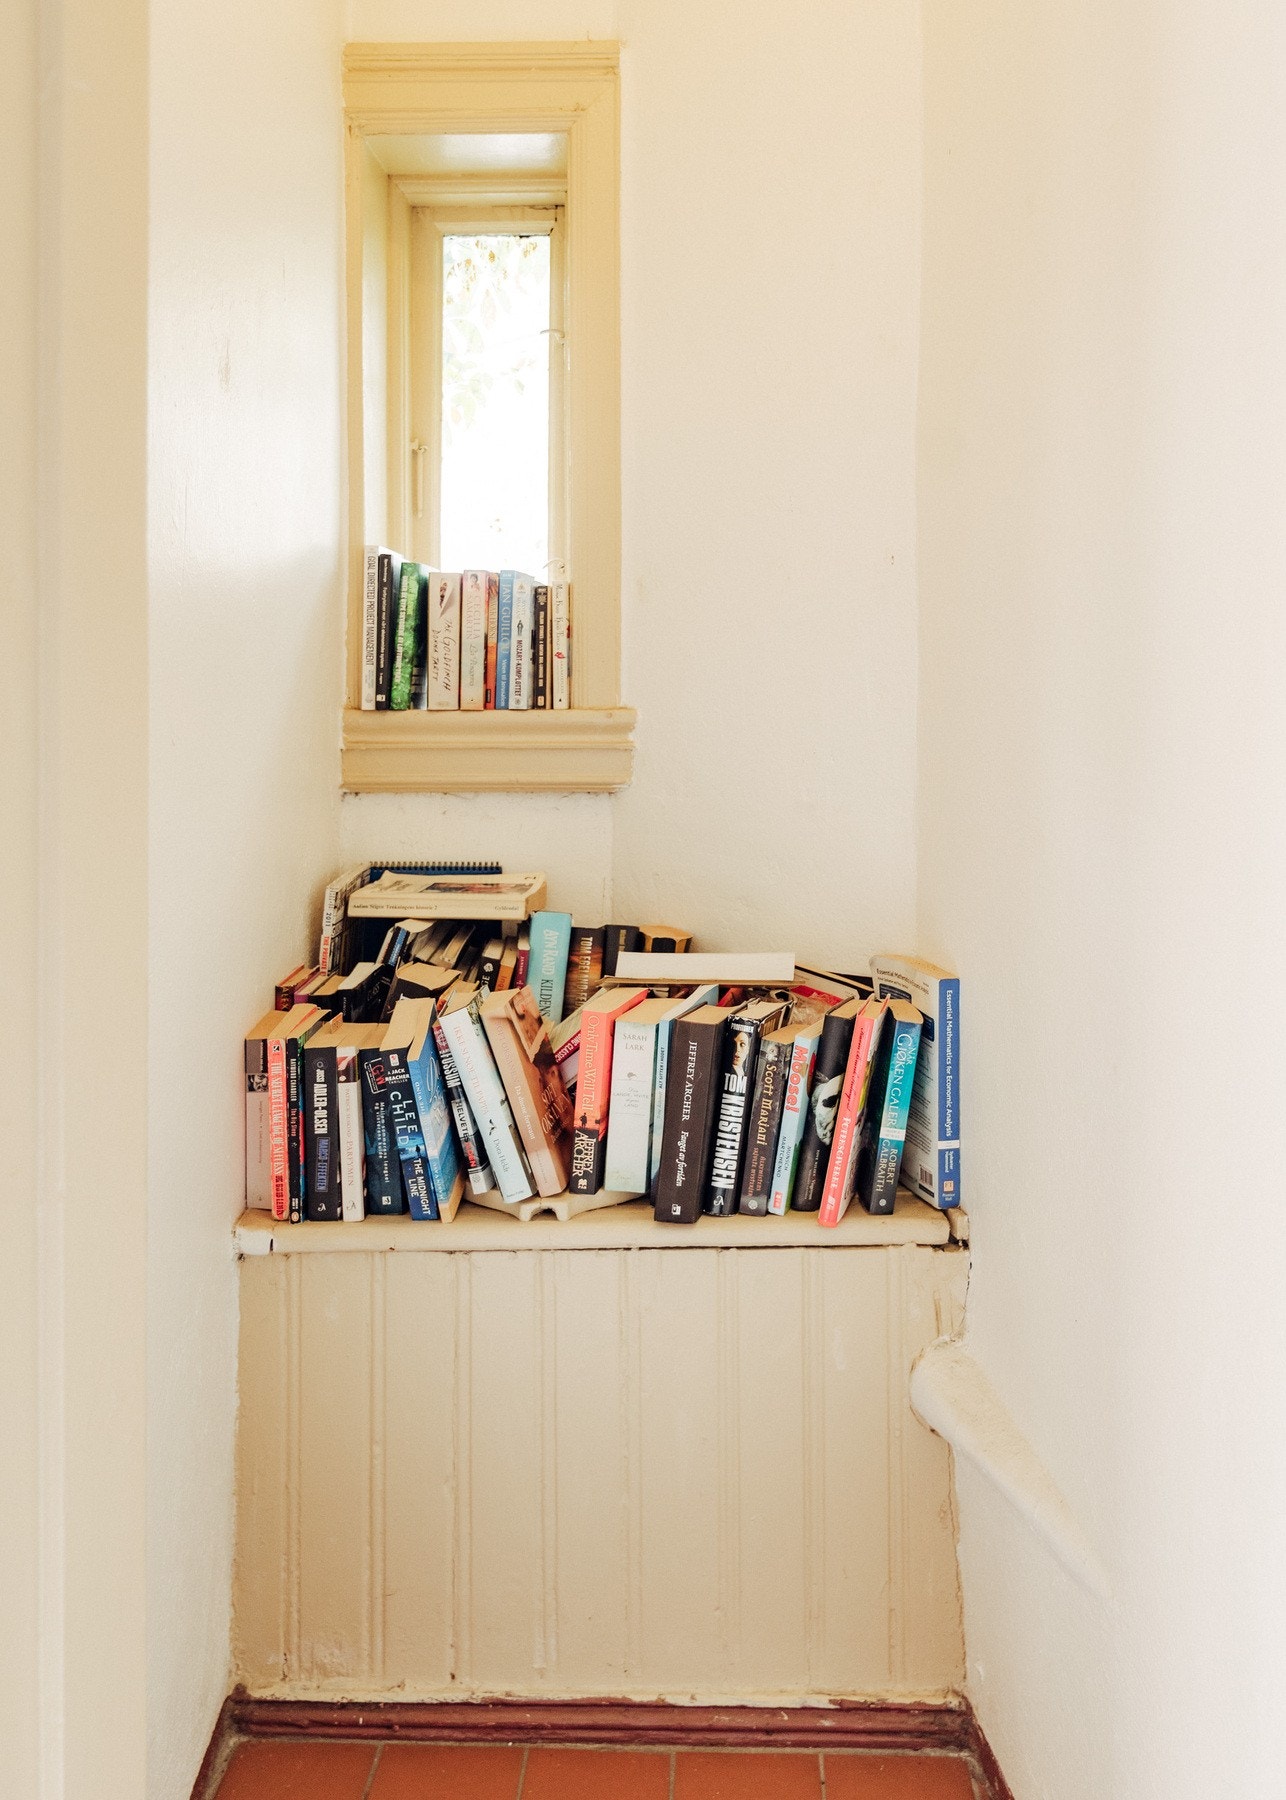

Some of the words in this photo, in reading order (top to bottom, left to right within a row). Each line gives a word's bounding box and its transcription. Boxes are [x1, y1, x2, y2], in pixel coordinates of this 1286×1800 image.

[367, 555, 376, 571] GOAL
[366, 572, 376, 600] DIRECTED
[501, 584, 512, 604] JAN
[366, 601, 376, 626] PROJECT
[473, 596, 481, 640] CECILIA
[499, 606, 512, 654] GUILLOU
[365, 627, 375, 667] MANAGEMENT
[514, 639, 524, 697] MOZART-KOMPLOTTET
[324, 912, 333, 928] 2011
[543, 929, 560, 949] AYN
[580, 937, 593, 953] TOM
[541, 949, 558, 975] RAND
[579, 955, 592, 989] EGELAND
[539, 978, 554, 1017] KILDENS
[946, 989, 954, 1020] Essential
[584, 1015, 601, 1041] Only
[622, 1033, 648, 1042] SARAH
[946, 1020, 954, 1065] Mathematics
[585, 1041, 599, 1069] Time
[624, 1043, 645, 1051] LARK
[685, 1040, 698, 1081] JEFFREY
[892, 1033, 912, 1085] GJØKEN
[906, 1046, 918, 1065] NÅR
[271, 1063, 284, 1076] THE
[440, 1052, 462, 1089] FOSSUM
[583, 1069, 597, 1089] Will
[724, 1072, 748, 1094] TOM
[785, 1045, 809, 1113] Moose!
[271, 1077, 285, 1102] SECRET
[581, 1090, 595, 1111] Tell
[681, 1080, 694, 1122] ARCHER
[945, 1075, 953, 1104] Economic
[271, 1103, 286, 1137] LANGUAGE
[314, 1083, 328, 1135] ADLER-OLSEN
[390, 1090, 410, 1147] CHILD
[403, 1100, 419, 1133] LEE
[887, 1087, 902, 1128] GALER
[945, 1105, 954, 1137] Analysis
[572, 1129, 588, 1177] ARCHER
[583, 1137, 597, 1174] JEFFREY
[677, 1131, 690, 1152] Fanget
[710, 1093, 746, 1190] KRISTENSEN
[776, 1135, 788, 1178] MARTCHENKO
[412, 1158, 423, 1174] THE
[675, 1159, 688, 1187] fortiden
[784, 1145, 792, 1172] MUNSCH
[875, 1139, 890, 1192] GALBRAITH
[886, 1148, 899, 1185] ROBERT
[408, 1178, 420, 1198] LINE
[414, 1175, 431, 1216] MIDNIGHT
